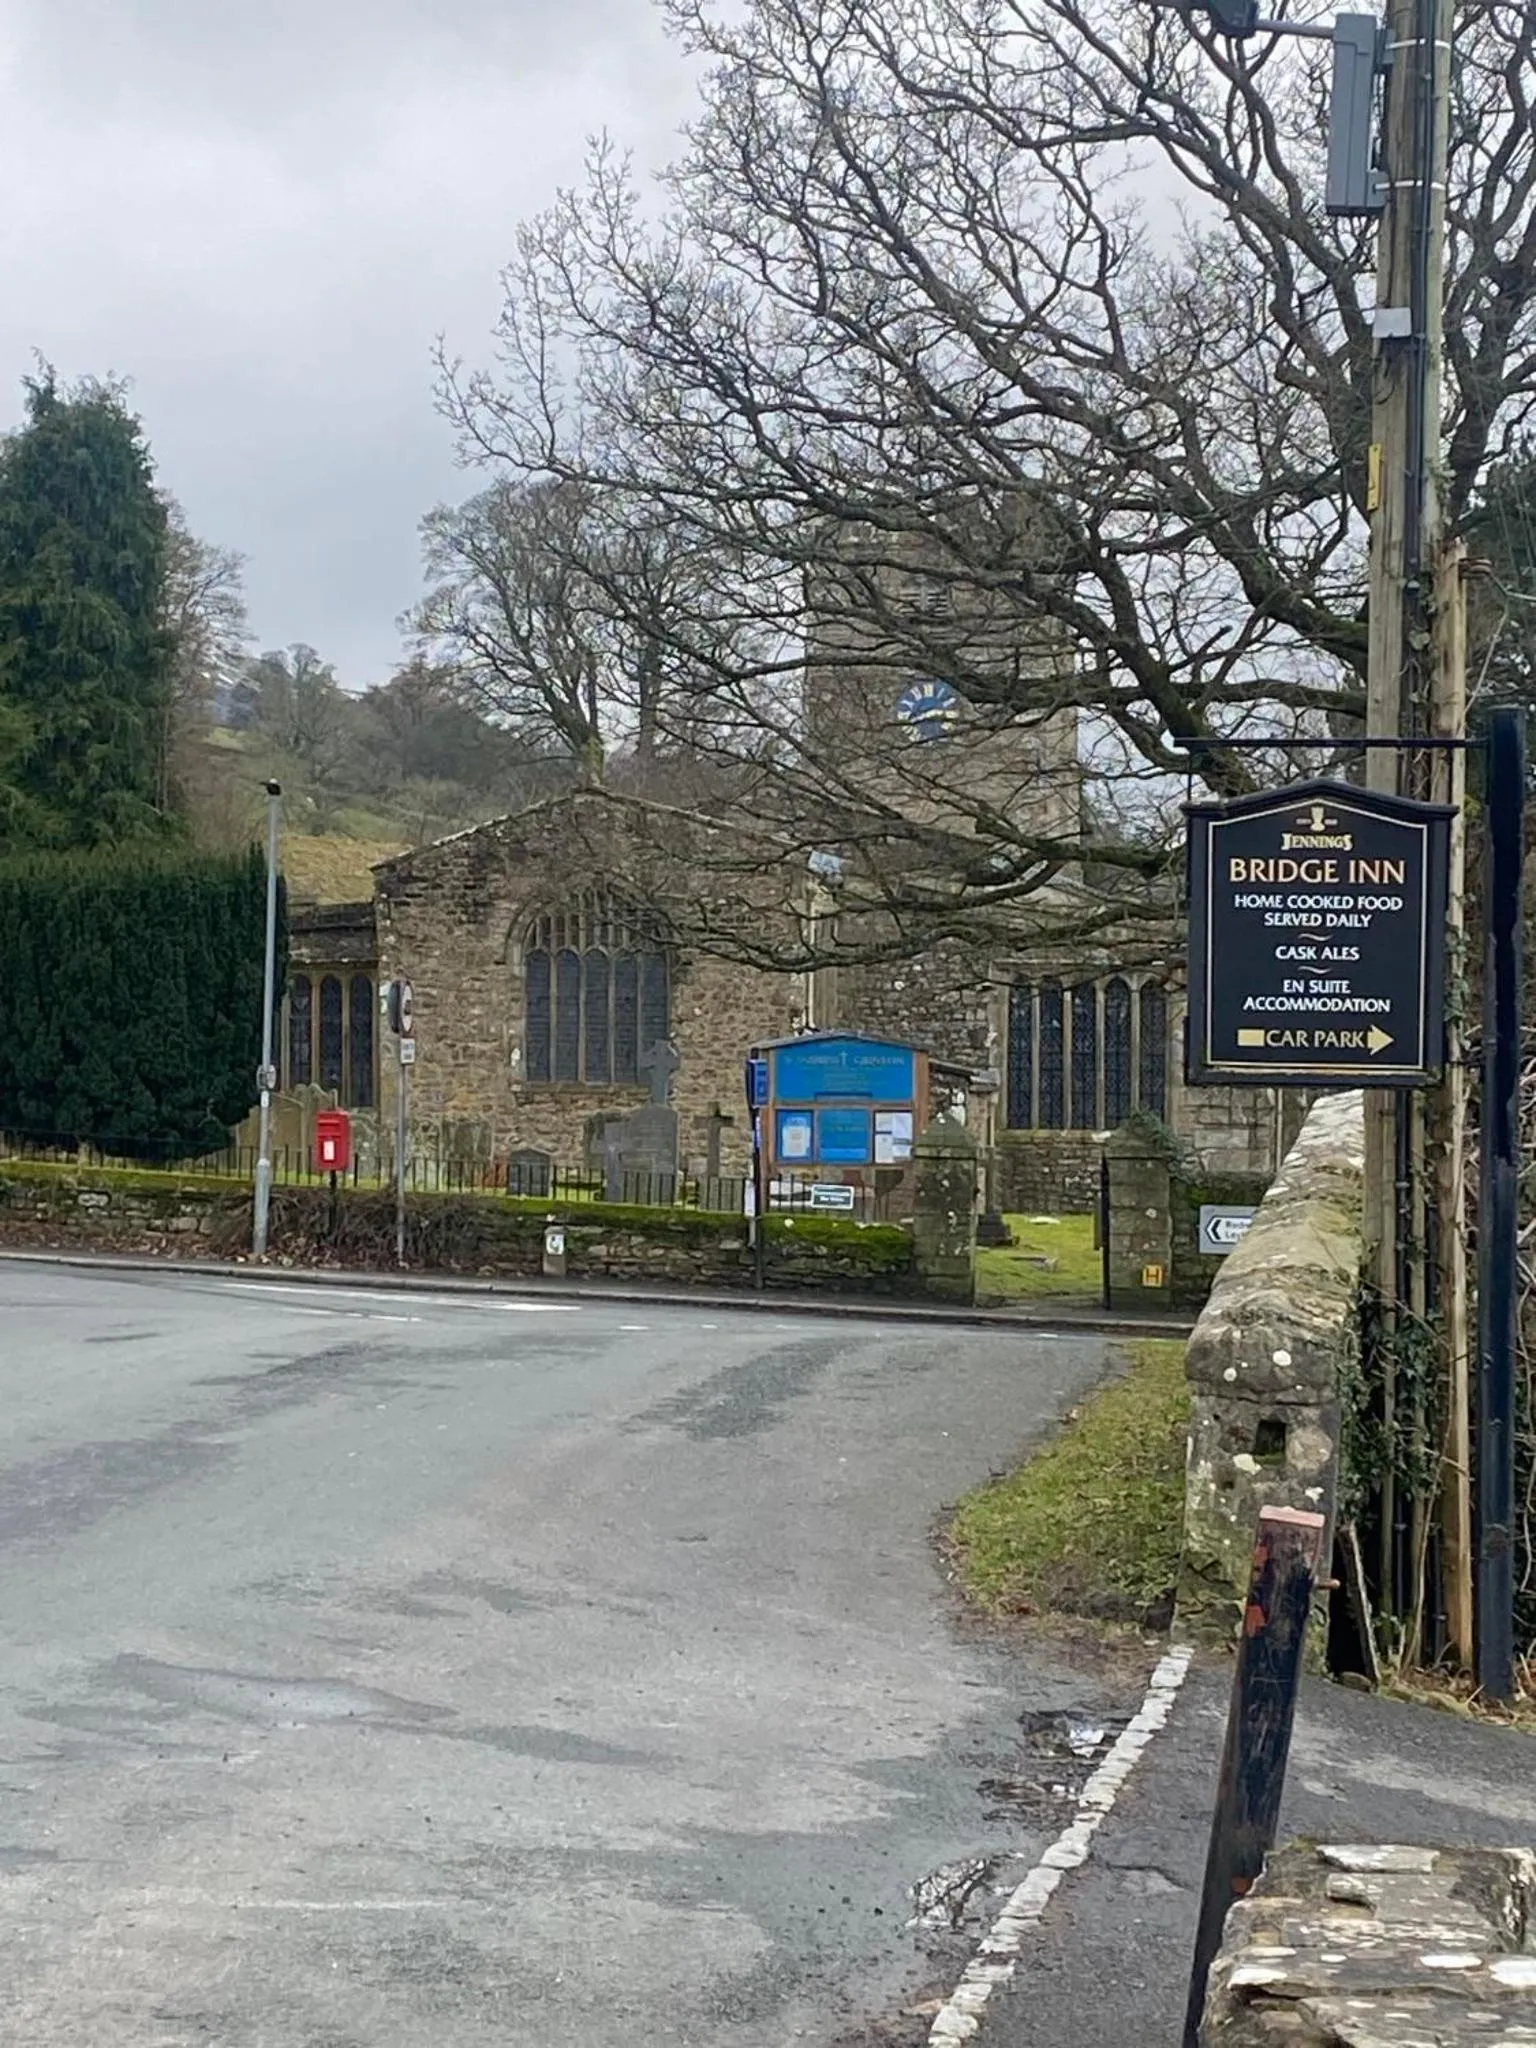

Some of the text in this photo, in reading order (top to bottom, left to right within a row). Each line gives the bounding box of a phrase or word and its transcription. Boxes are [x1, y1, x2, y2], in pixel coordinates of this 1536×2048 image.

[1281, 833, 1353, 851] JENNINGS
[1230, 858, 1406, 884] BRIDGE INN
[1234, 894, 1402, 910] HOME COOKED FOOD
[1264, 912, 1372, 928] SERVED DAILY
[1276, 946, 1360, 960] CASK ALES
[1283, 980, 1350, 994] EN SUITE
[1243, 996, 1390, 1012] ACCOMMODATION
[1266, 1030, 1364, 1048] CAR PARK
[1145, 1267, 1160, 1284] H
